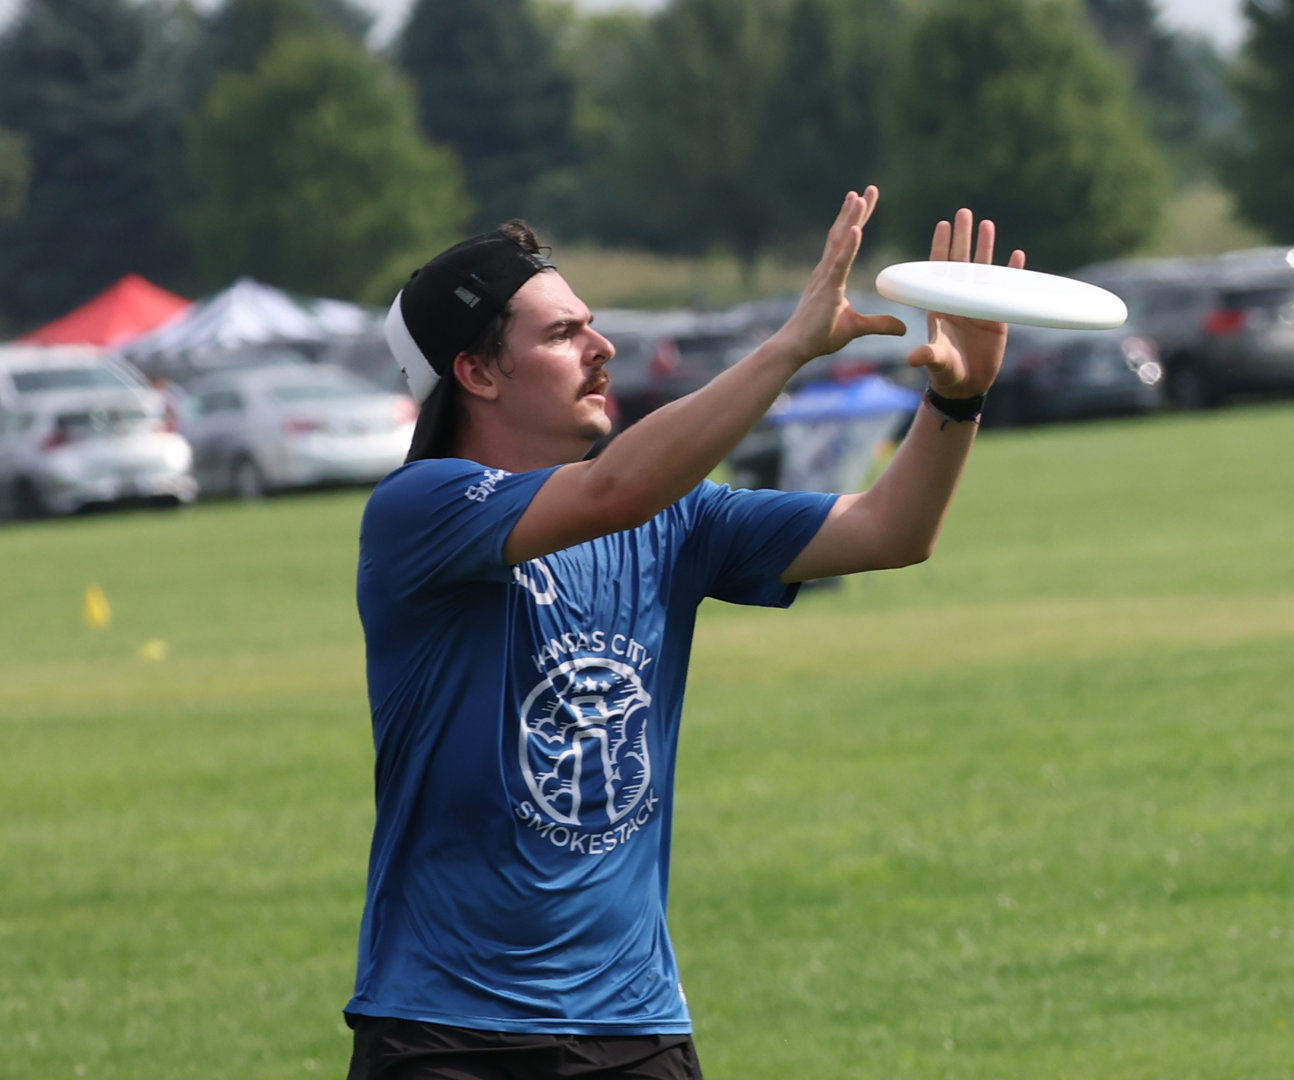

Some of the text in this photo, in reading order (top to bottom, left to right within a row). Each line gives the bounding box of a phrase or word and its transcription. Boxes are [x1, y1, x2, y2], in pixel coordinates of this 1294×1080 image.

[531, 631, 652, 673] KANSAS CITY
[515, 789, 659, 854] SMOKESTACK
